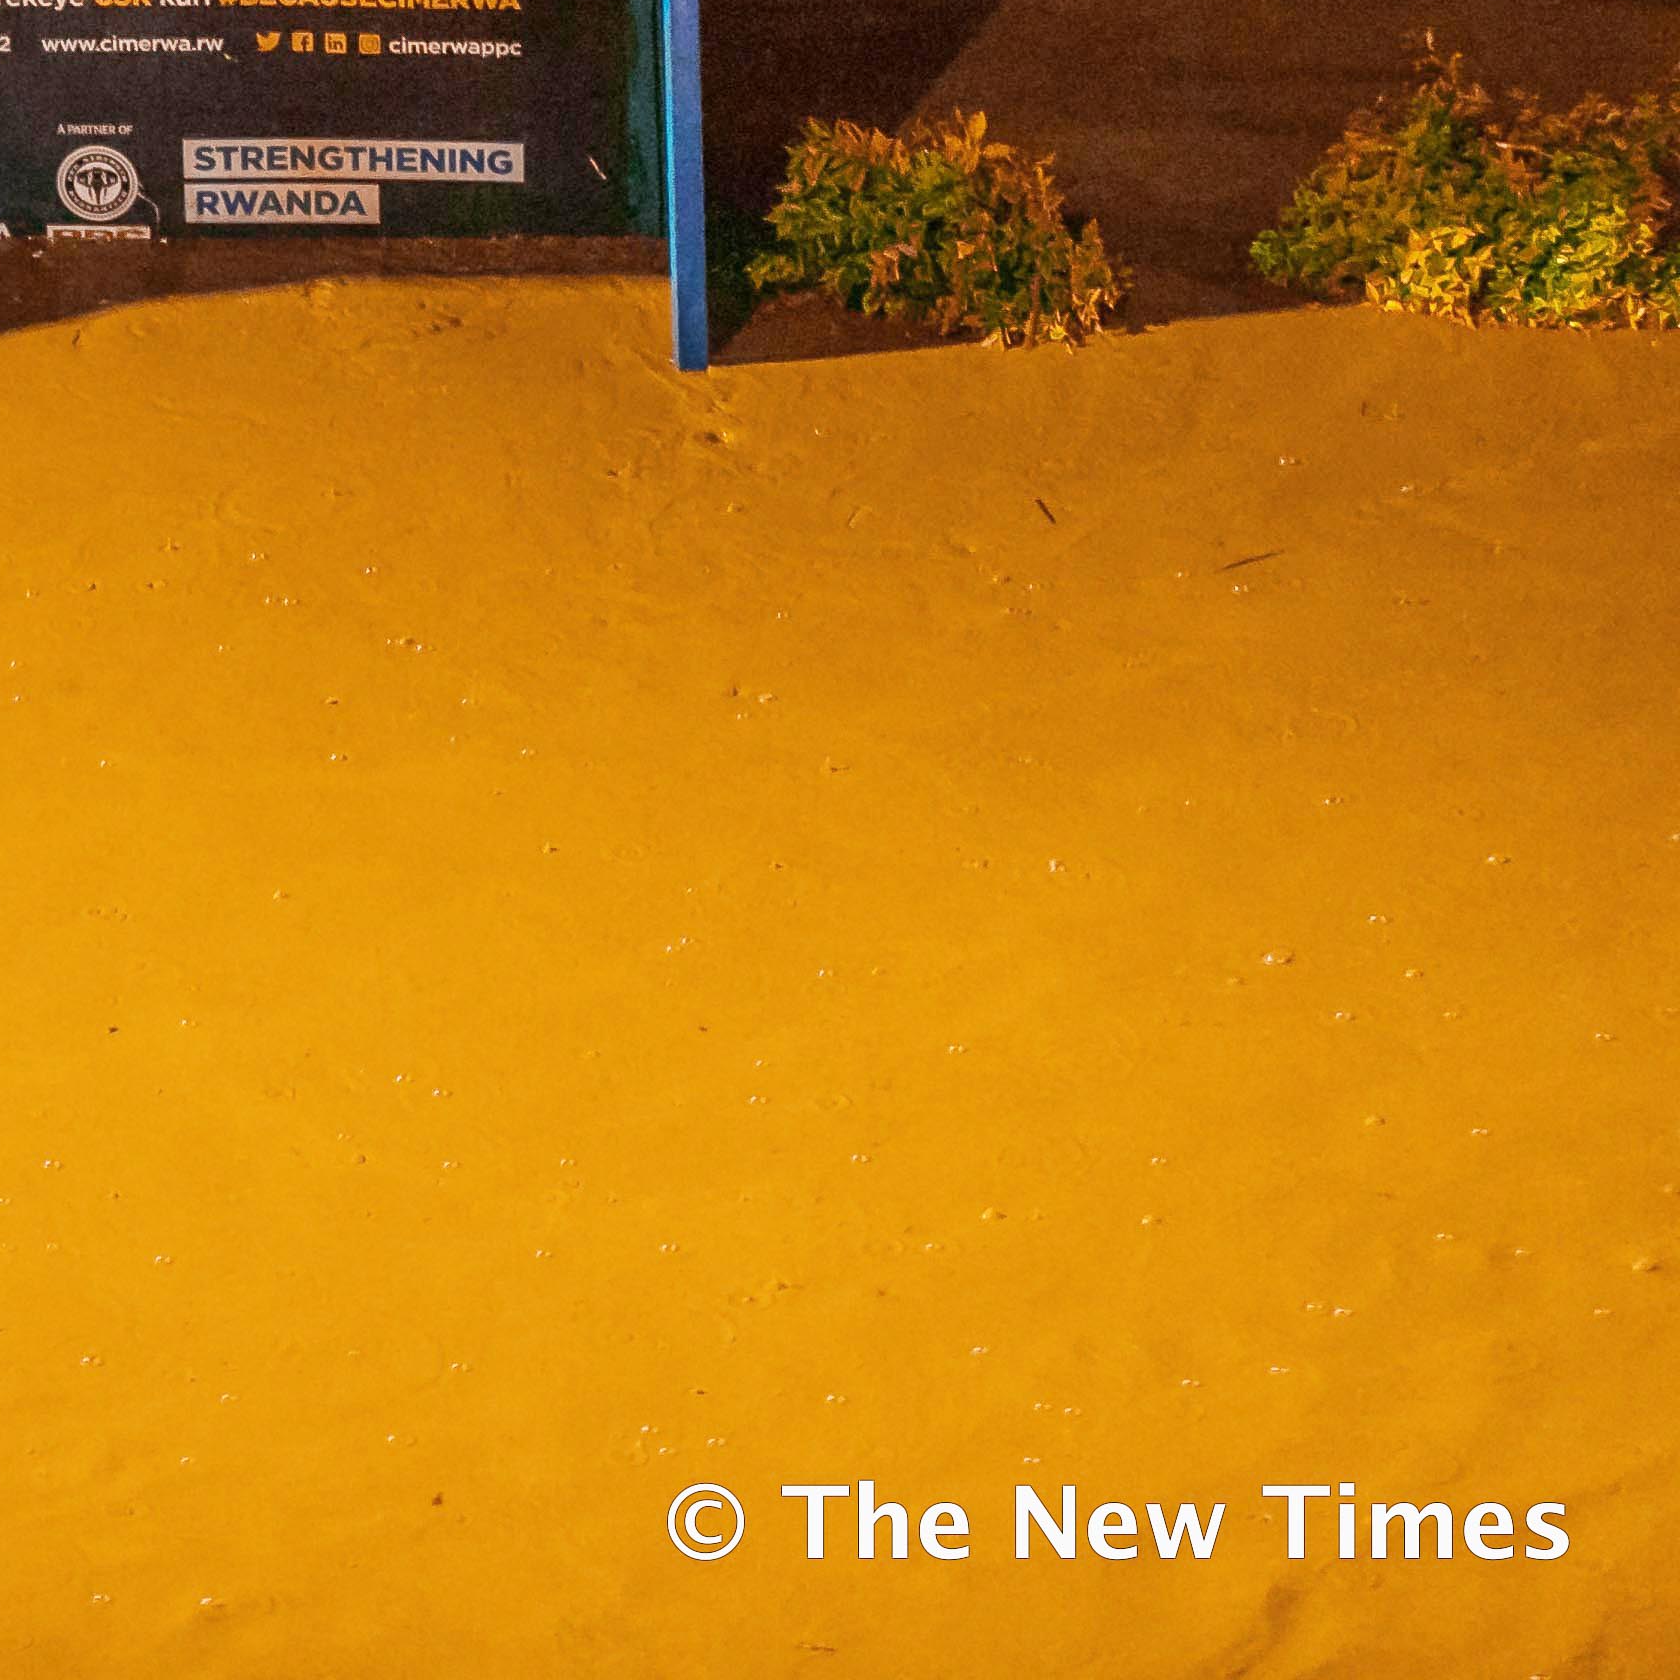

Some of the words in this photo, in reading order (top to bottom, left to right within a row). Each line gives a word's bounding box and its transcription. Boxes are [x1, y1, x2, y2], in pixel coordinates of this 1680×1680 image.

[41, 34, 224, 54] www.cimerwa.rw
[388, 36, 523, 58] cimerwappc
[57, 123, 65, 135] A
[67, 124, 116, 135] PARTNER
[118, 124, 133, 135] OF
[192, 144, 513, 175] STRENGTHENING
[195, 189, 368, 217] RWANDA
